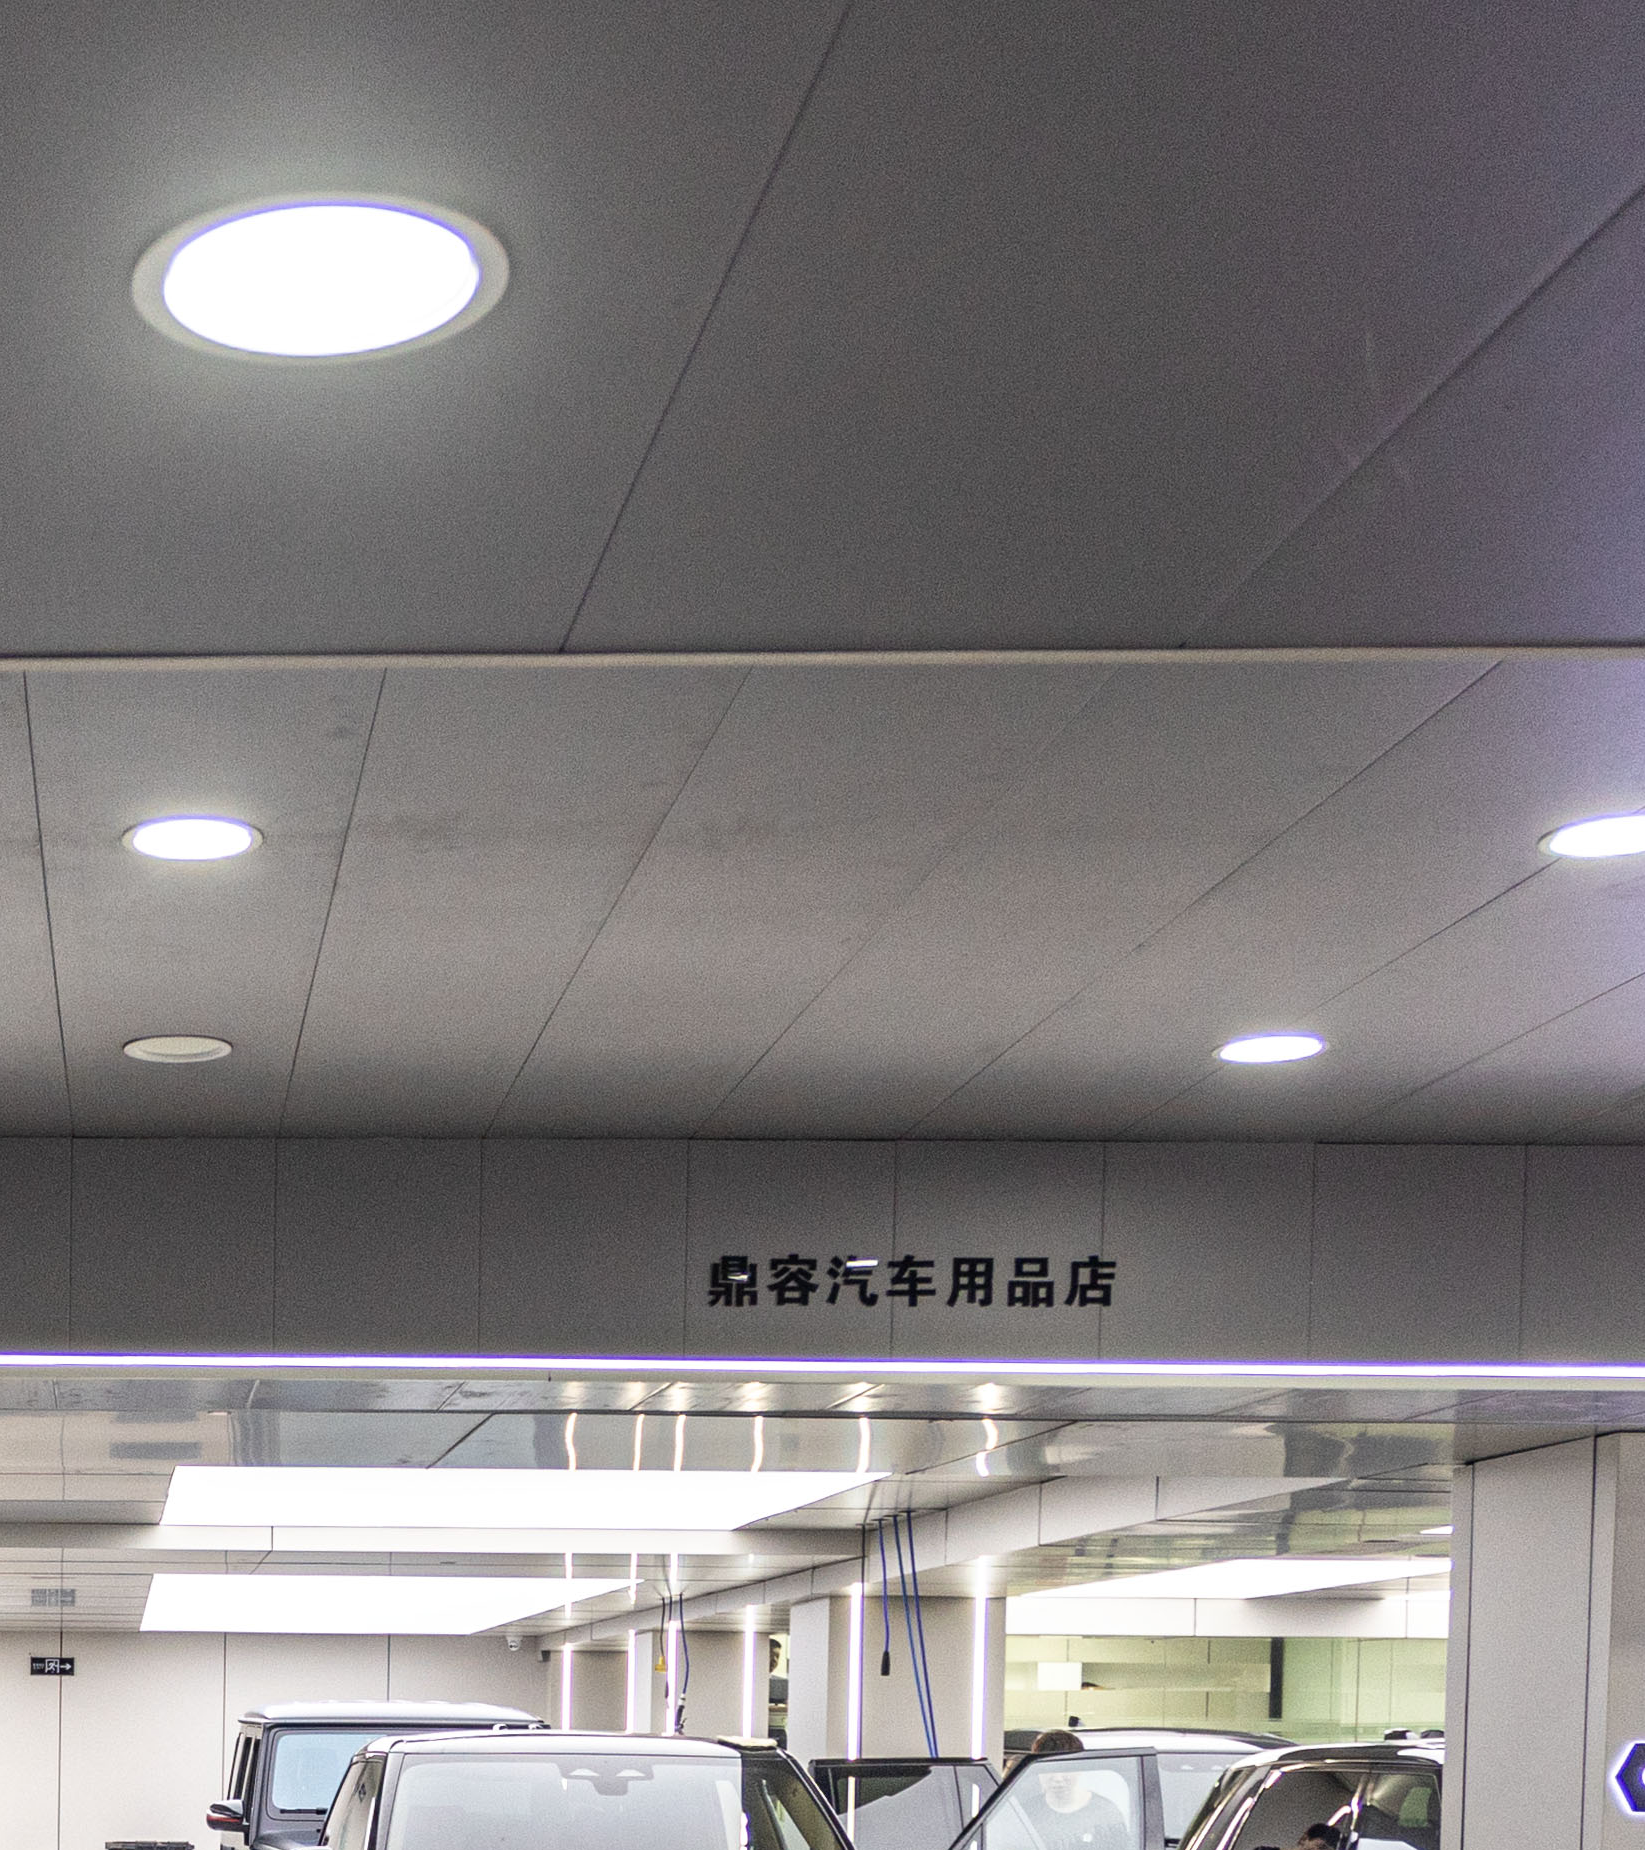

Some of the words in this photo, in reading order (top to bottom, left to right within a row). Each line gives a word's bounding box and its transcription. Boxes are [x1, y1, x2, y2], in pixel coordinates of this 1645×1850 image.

[707, 1254, 1117, 1308] 鼎容汽车用品店
